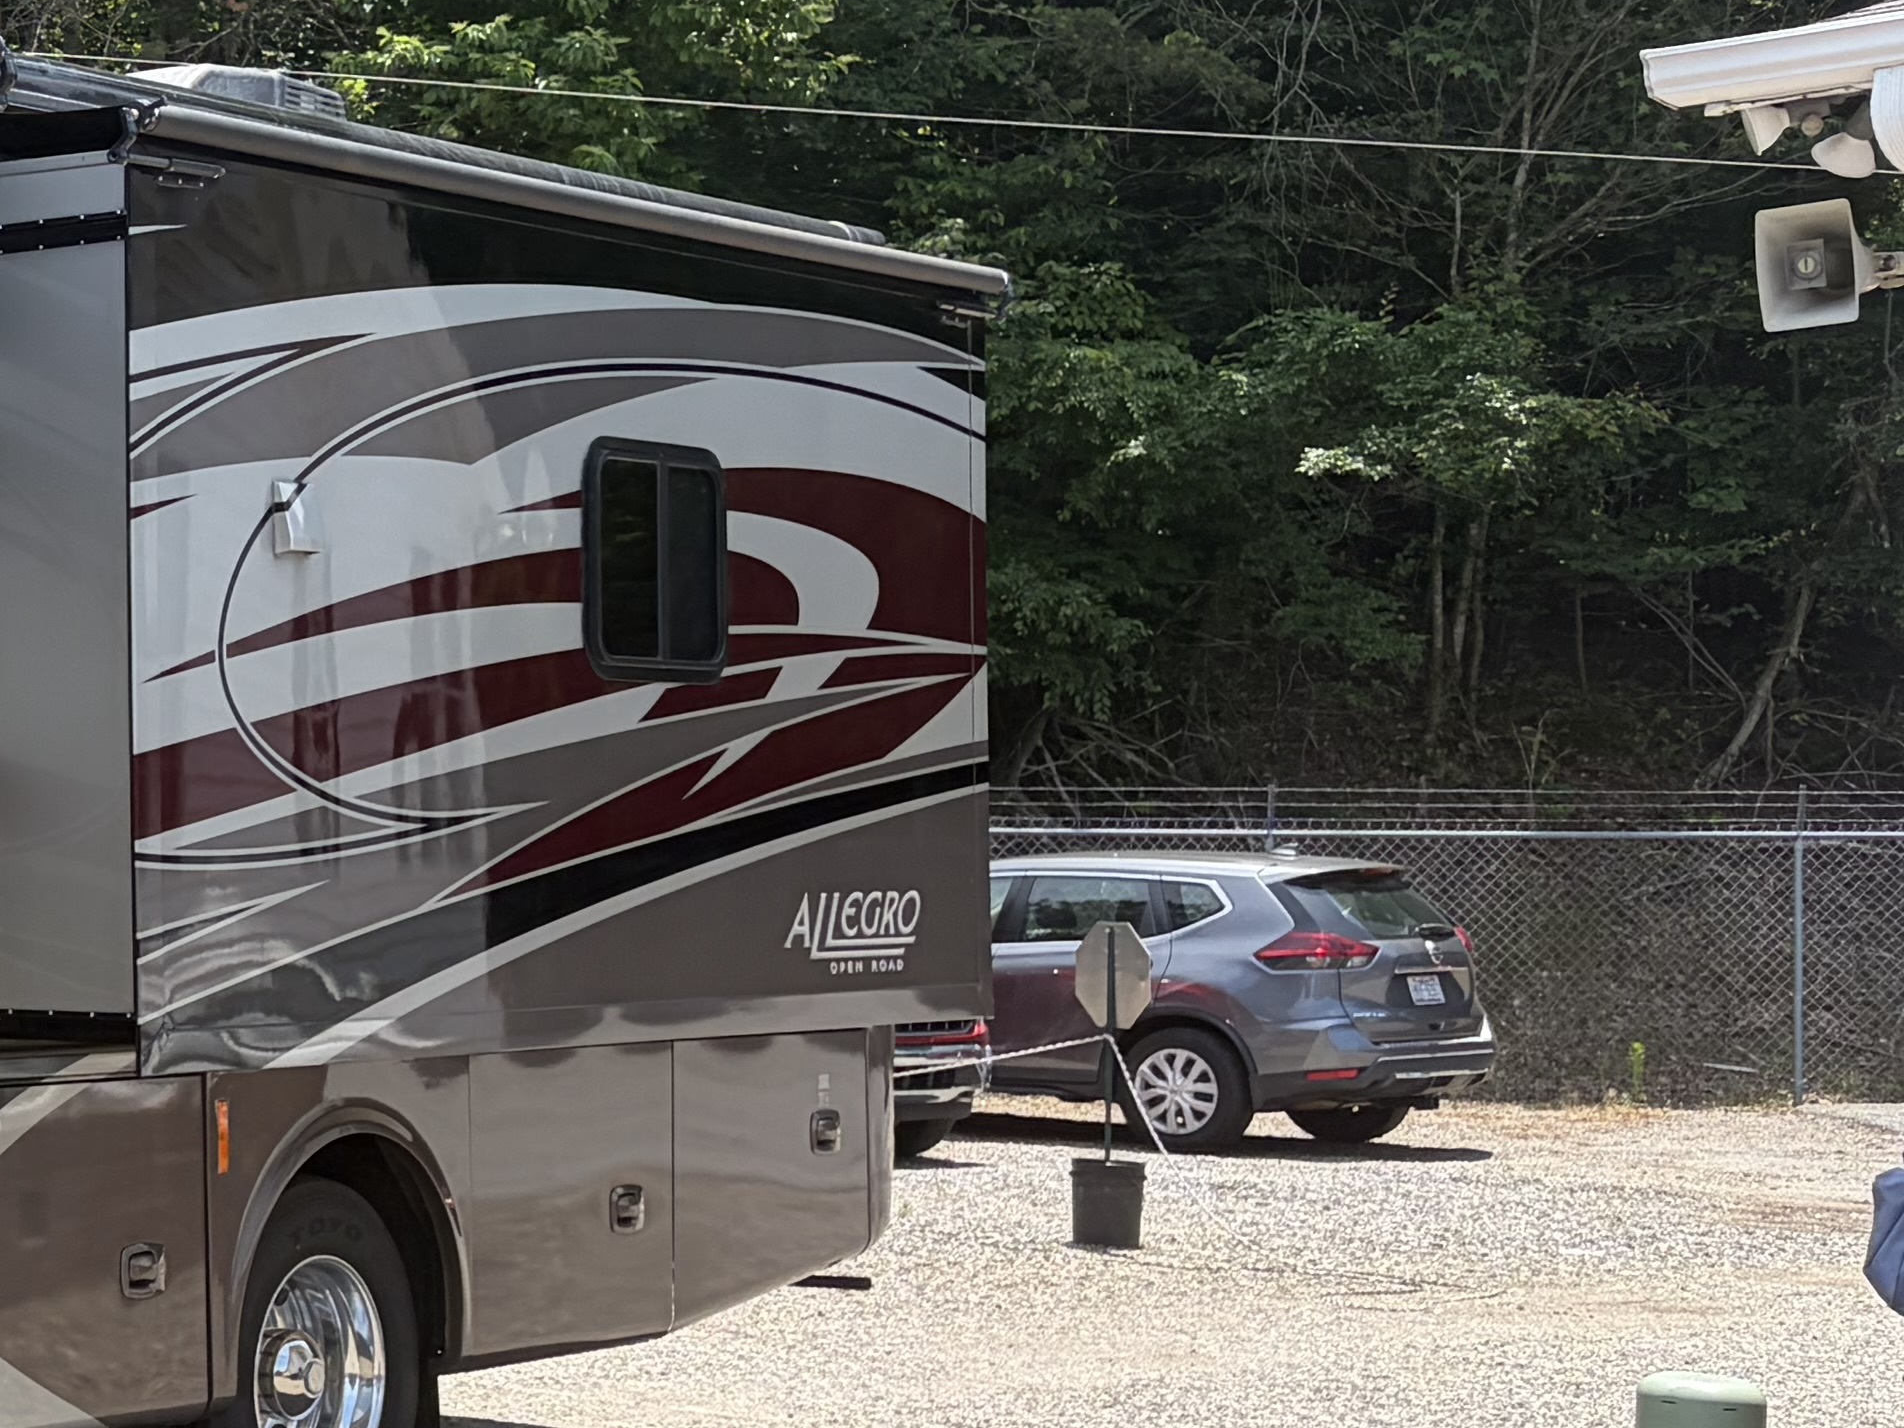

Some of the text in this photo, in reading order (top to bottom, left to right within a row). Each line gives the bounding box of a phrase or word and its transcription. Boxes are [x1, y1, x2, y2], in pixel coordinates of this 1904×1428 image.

[783, 889, 921, 960] ALLEGRO
[829, 958, 904, 975] OPEN ROAD
[287, 1216, 364, 1247] TOYO
